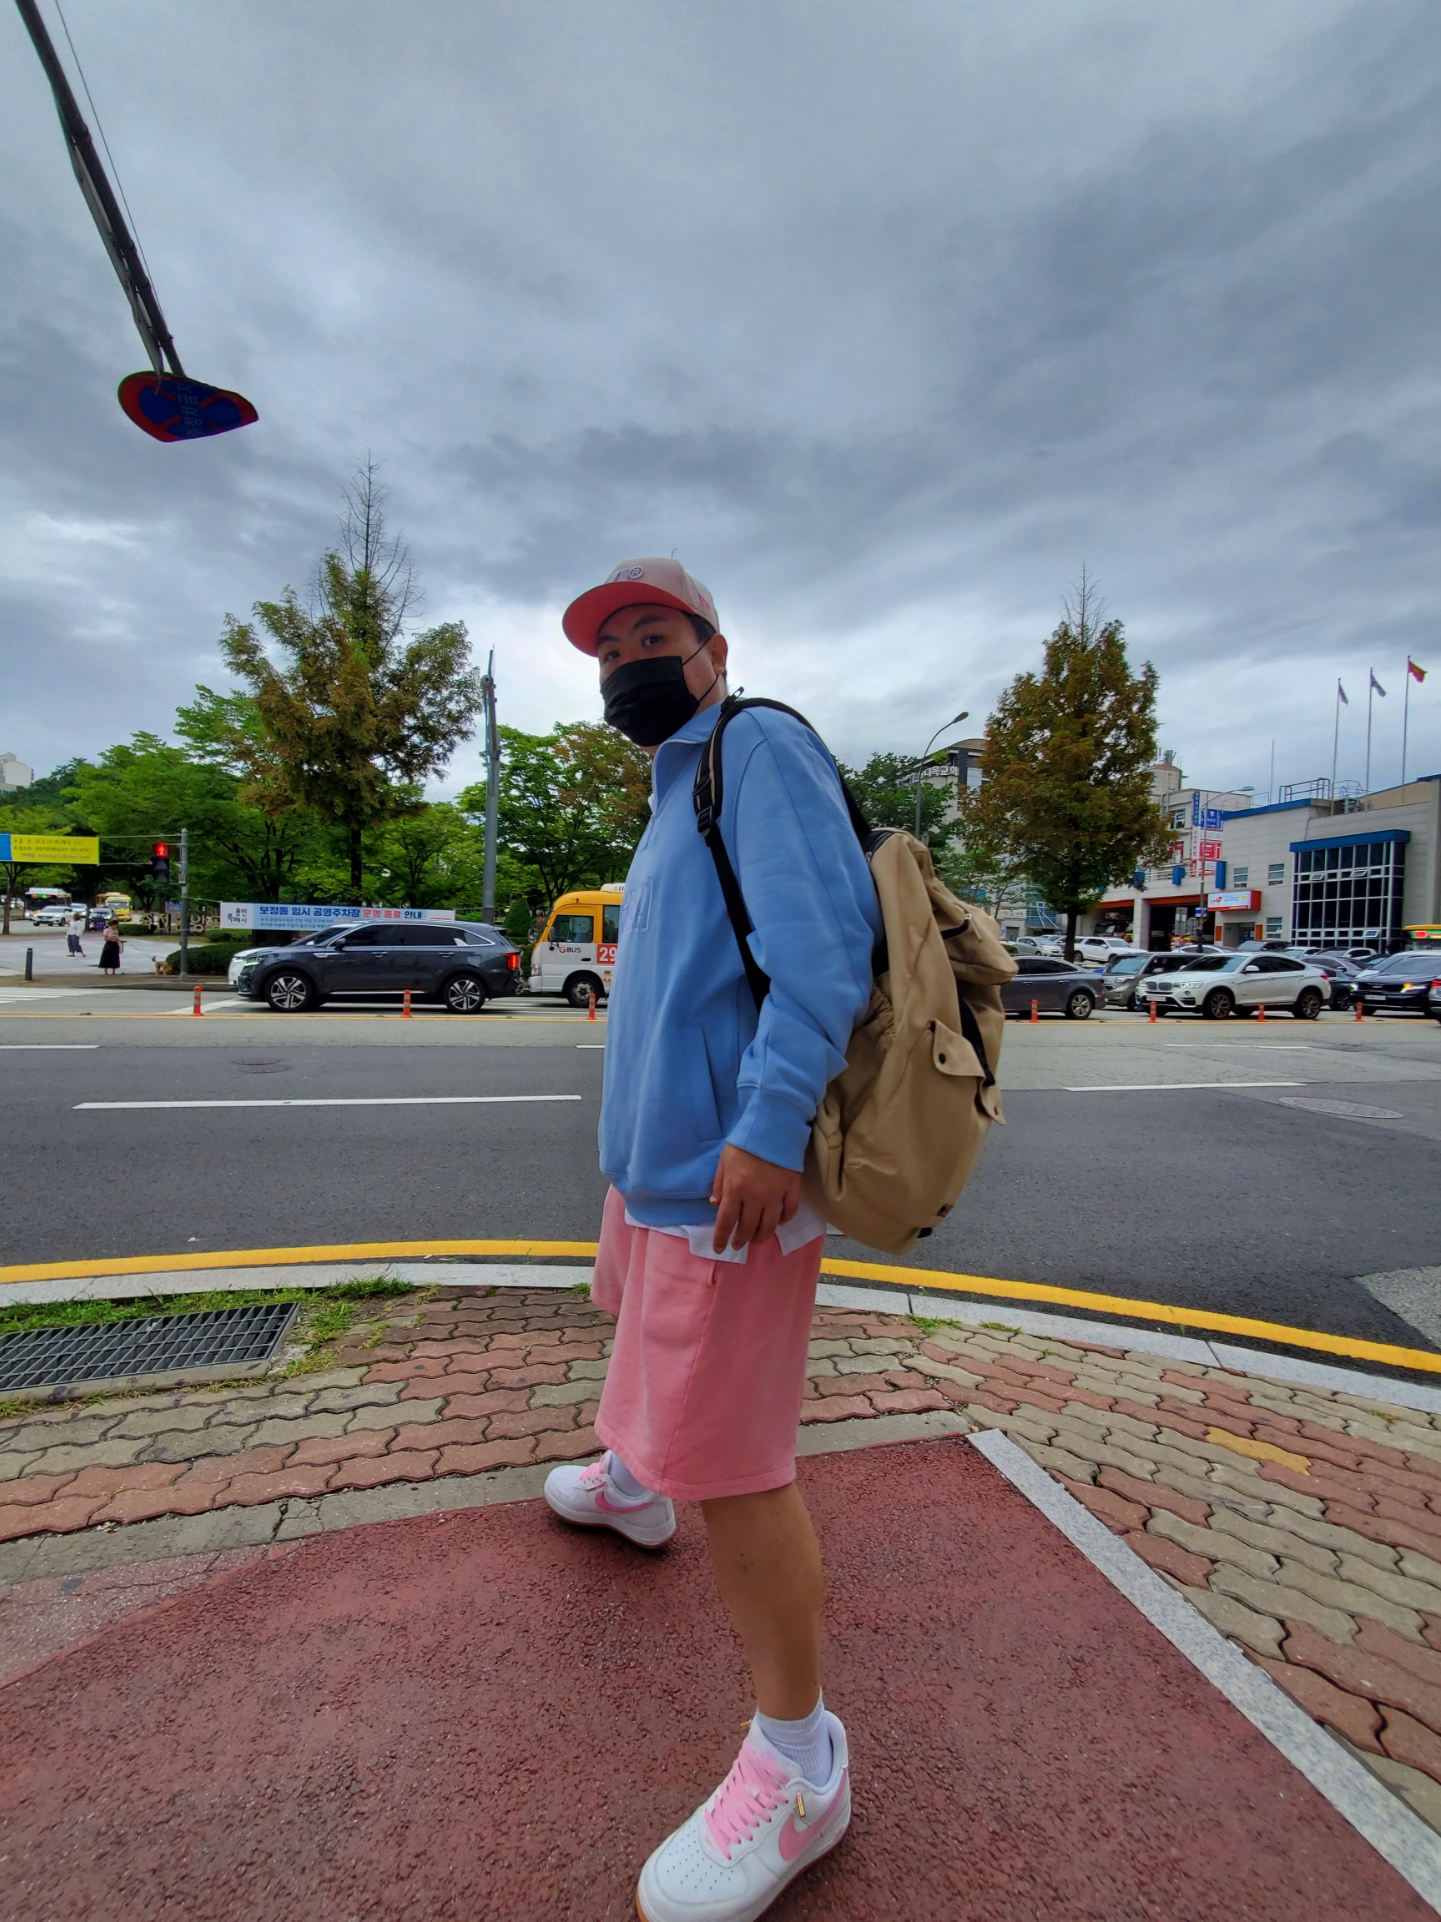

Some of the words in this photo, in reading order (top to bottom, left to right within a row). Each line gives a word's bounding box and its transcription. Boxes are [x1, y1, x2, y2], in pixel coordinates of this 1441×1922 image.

[235, 907, 248, 917] 용인
[259, 906, 289, 916] 보정동
[292, 907, 311, 917] 임시
[313, 908, 360, 918] 공영주차장
[363, 909, 381, 918] 운영
[384, 910, 401, 918] 종료
[404, 911, 422, 919] 안내
